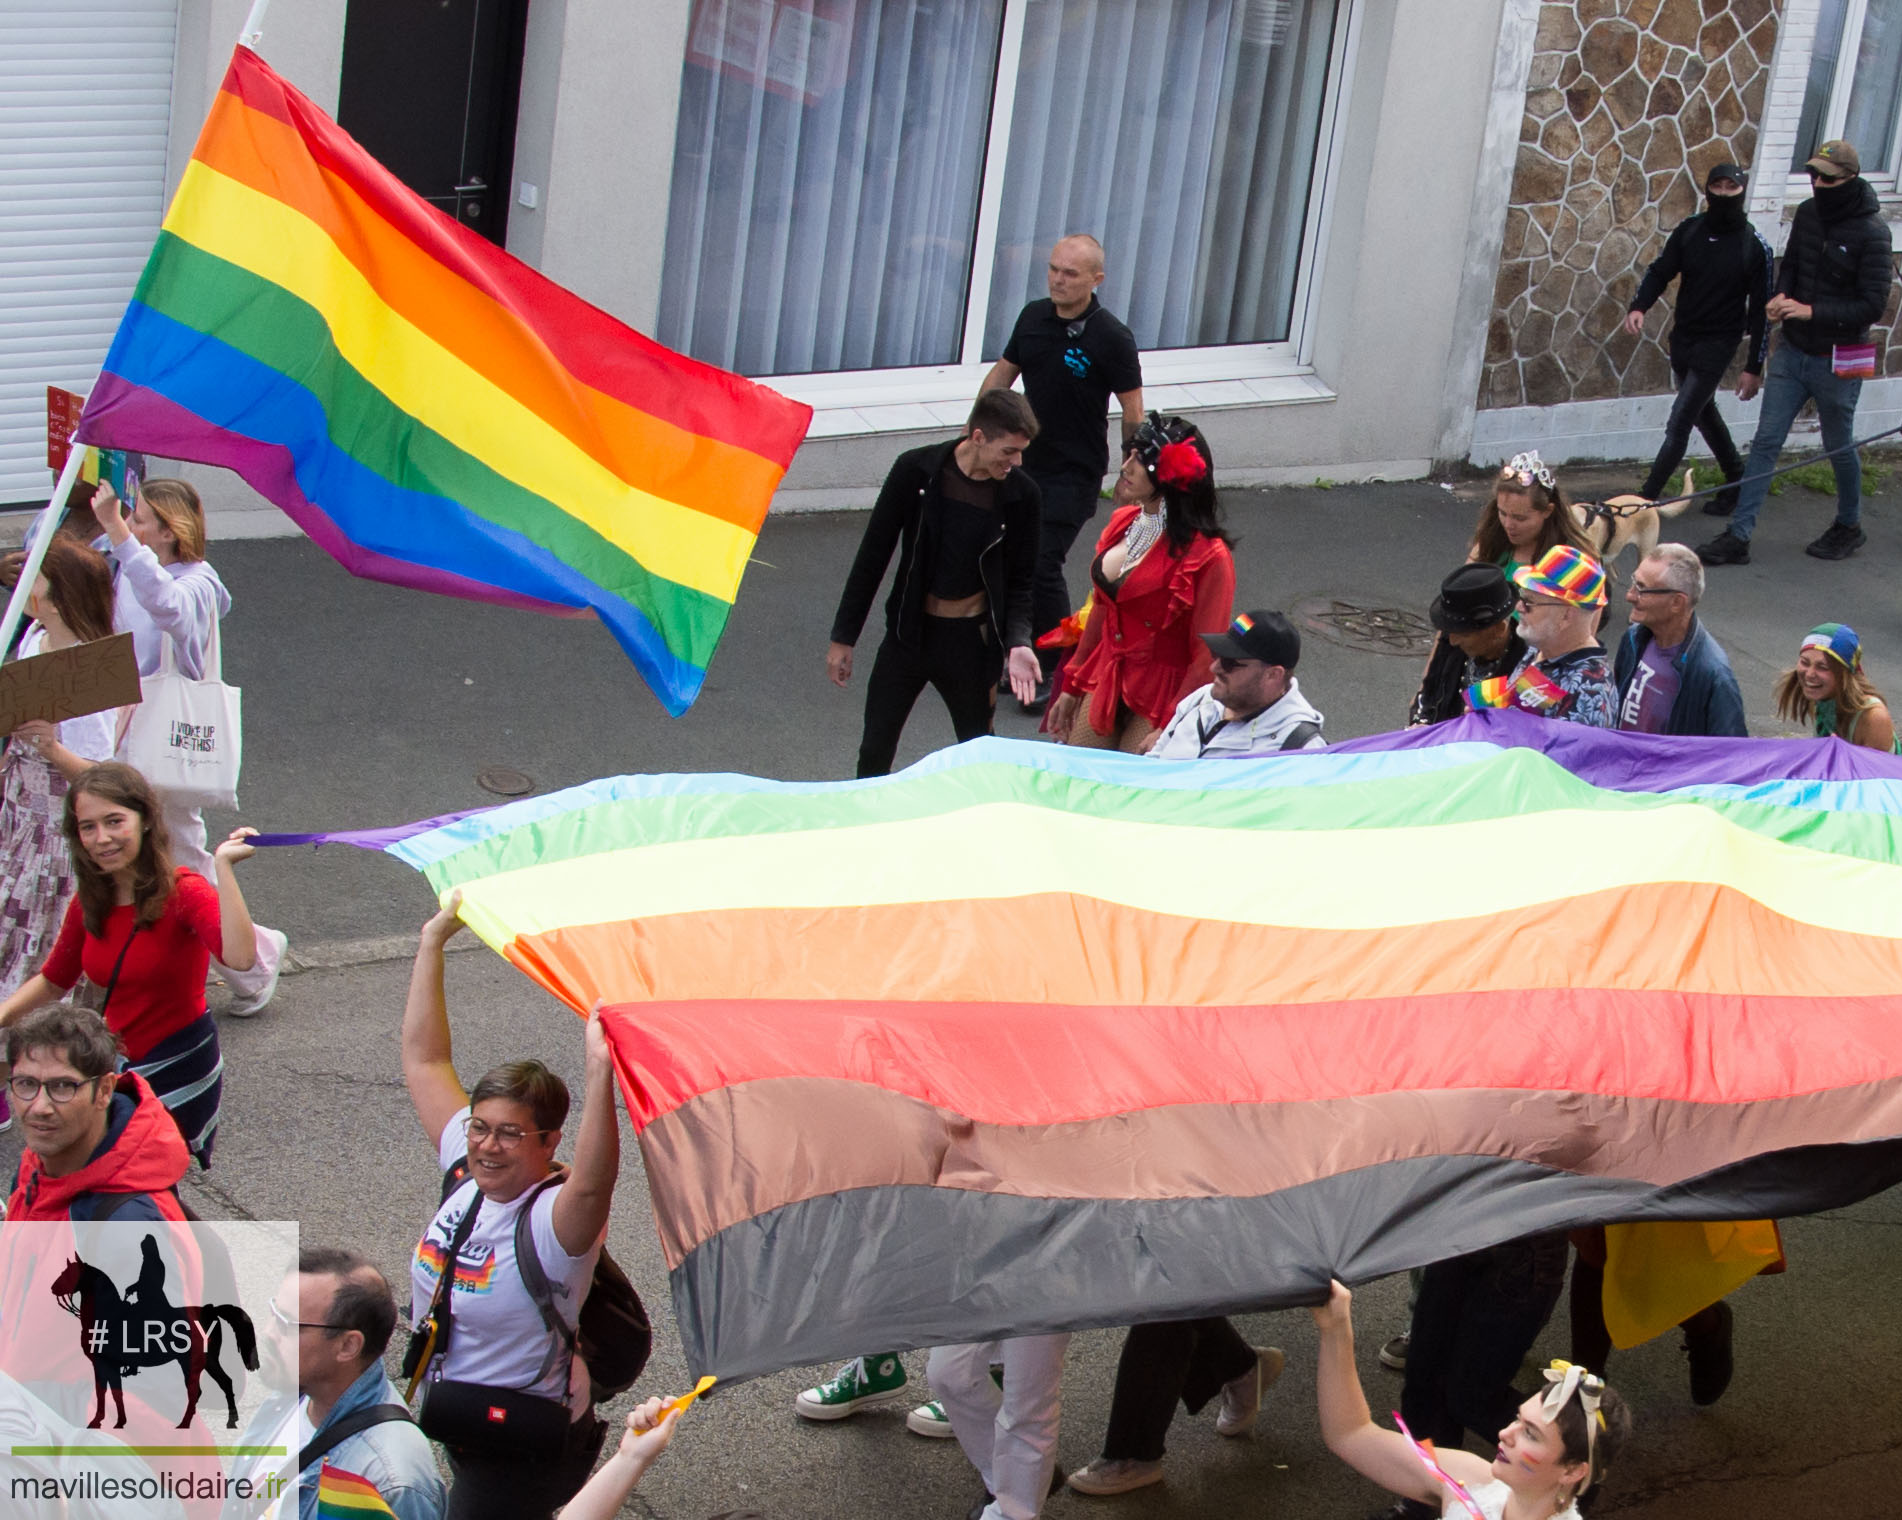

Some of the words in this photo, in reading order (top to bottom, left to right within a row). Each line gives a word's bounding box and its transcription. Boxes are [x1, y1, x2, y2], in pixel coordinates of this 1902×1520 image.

[177, 721, 201, 737] WOKE
[203, 725, 215, 738] UP
[170, 733, 188, 749] LIKE
[191, 738, 215, 752] THIS!
